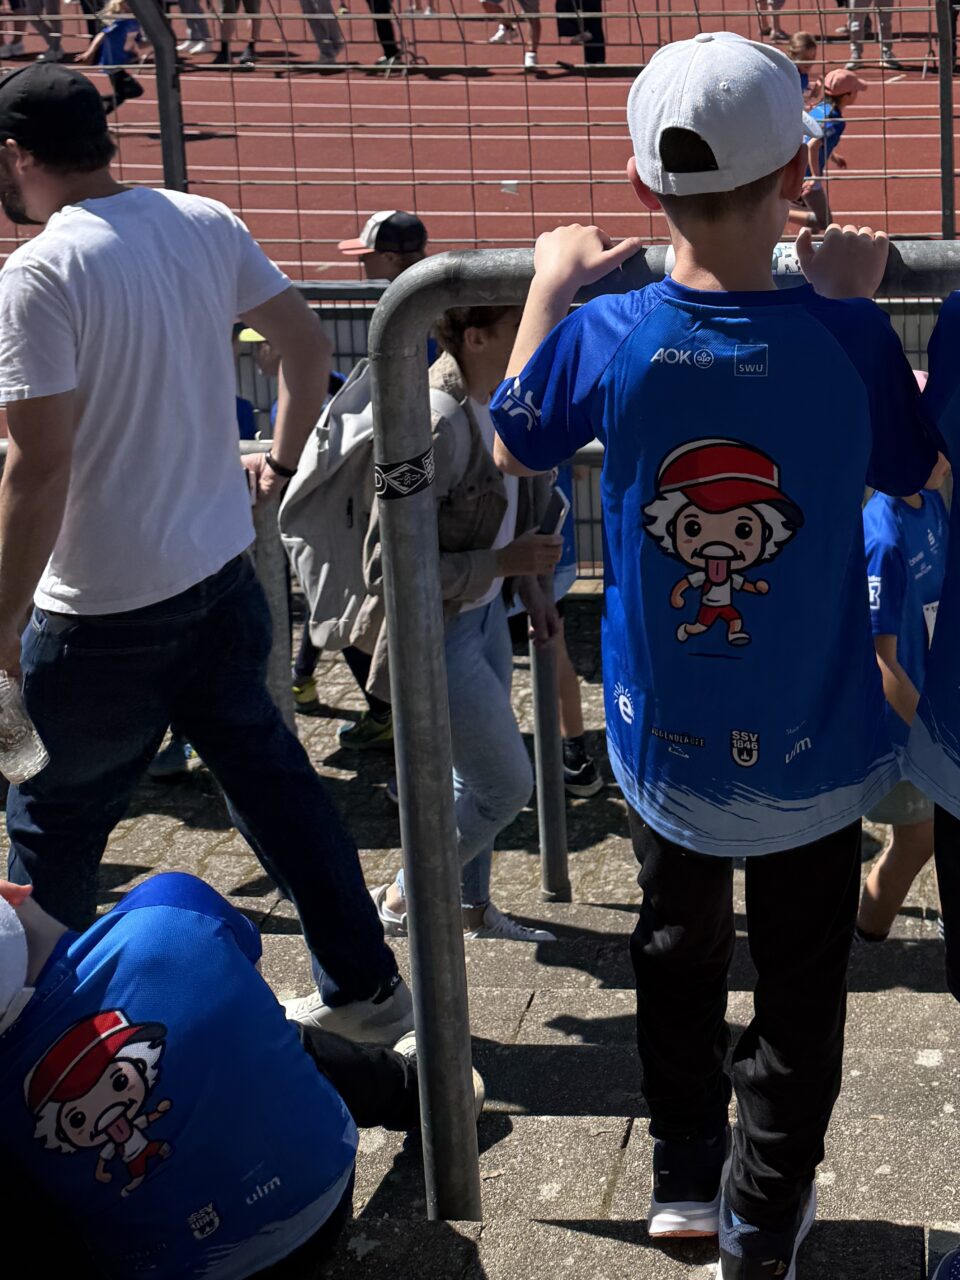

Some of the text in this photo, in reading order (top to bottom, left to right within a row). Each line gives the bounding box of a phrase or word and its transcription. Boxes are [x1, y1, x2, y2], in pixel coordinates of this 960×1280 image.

[650, 347, 692, 365] AOK
[739, 363, 764, 373] SWU
[731, 730, 759, 742] SSV
[731, 740, 759, 750] 1846
[246, 1176, 281, 1205] ulm
